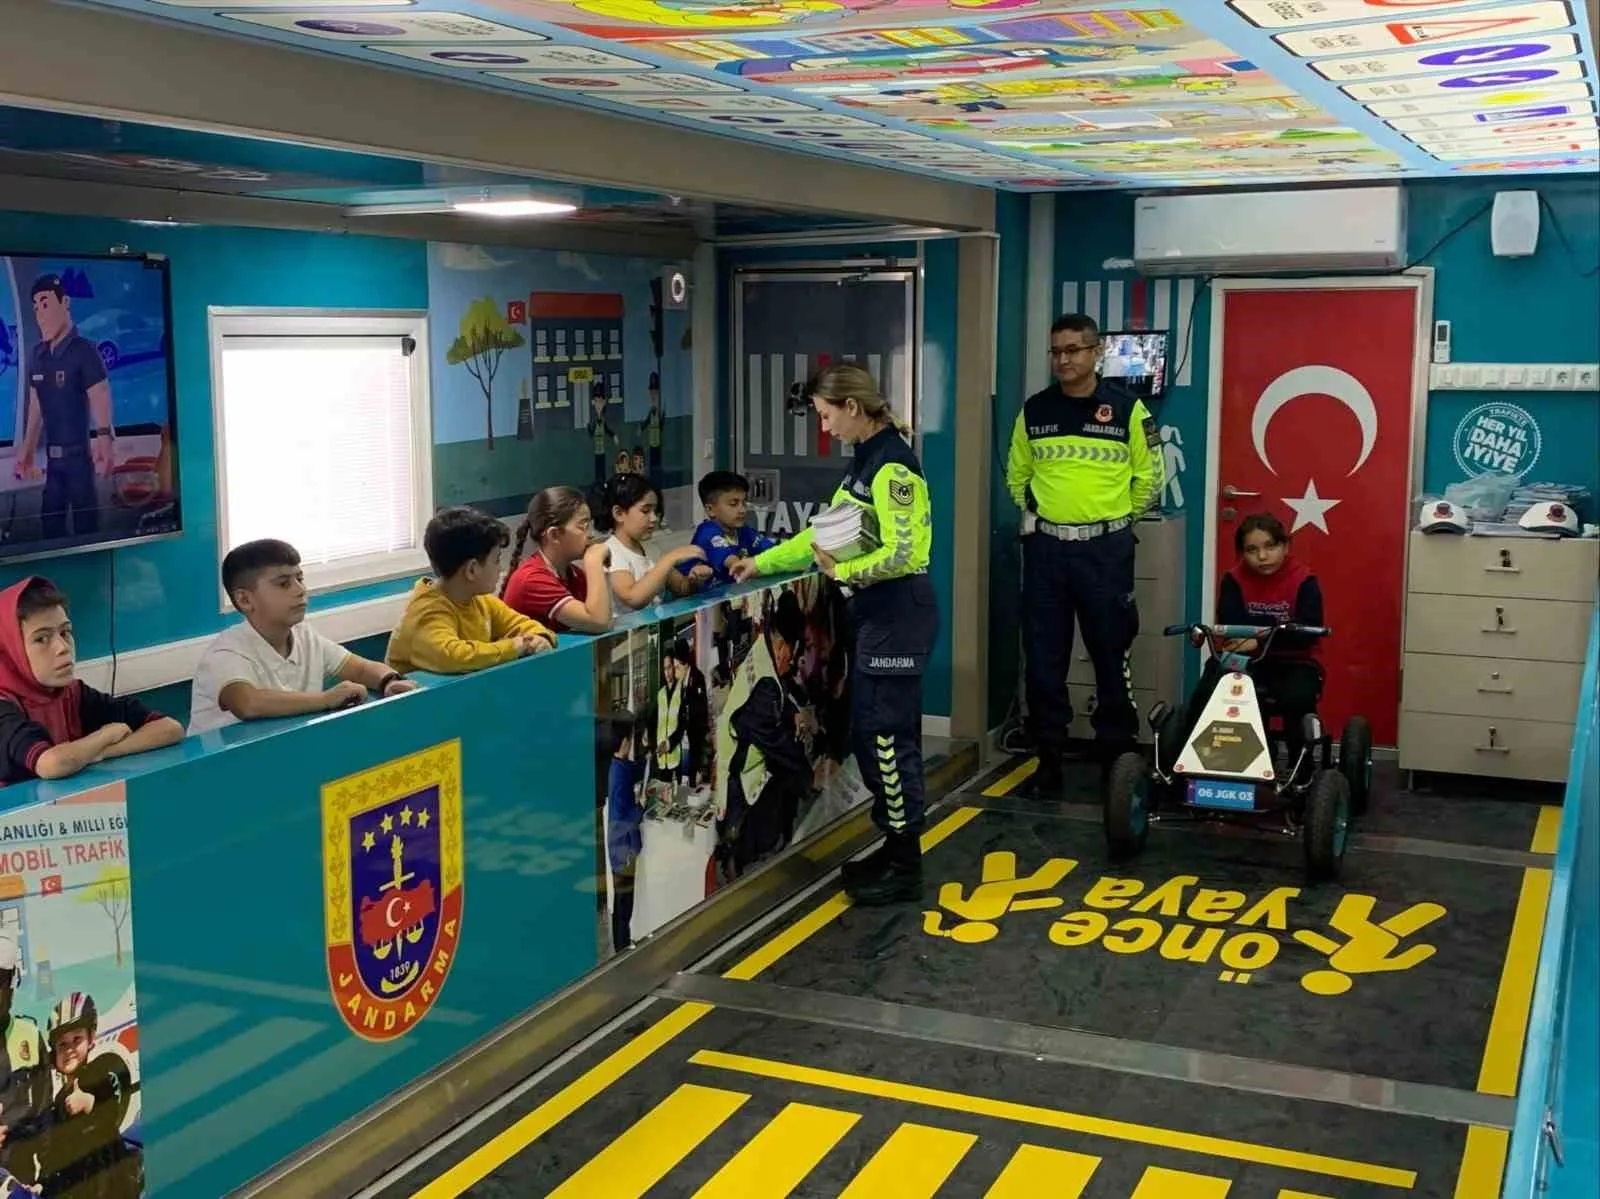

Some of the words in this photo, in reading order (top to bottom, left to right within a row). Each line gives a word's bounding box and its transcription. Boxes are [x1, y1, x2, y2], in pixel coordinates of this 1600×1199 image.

[1470, 427, 1522, 458] DAHA
[1477, 416, 1506, 434] HER
[1508, 425, 1528, 442] YIL
[1463, 442, 1519, 474] İYİYE
[869, 656, 915, 669] JANDARMA
[1198, 787, 1214, 798] 06
[1215, 788, 1237, 800] JGK
[60, 821, 67, 835] &
[63, 835, 126, 865] TRAFİK
[1084, 875, 1302, 930] yaya
[1048, 910, 1280, 984] önce
[339, 918, 457, 1031] JANDARMA
